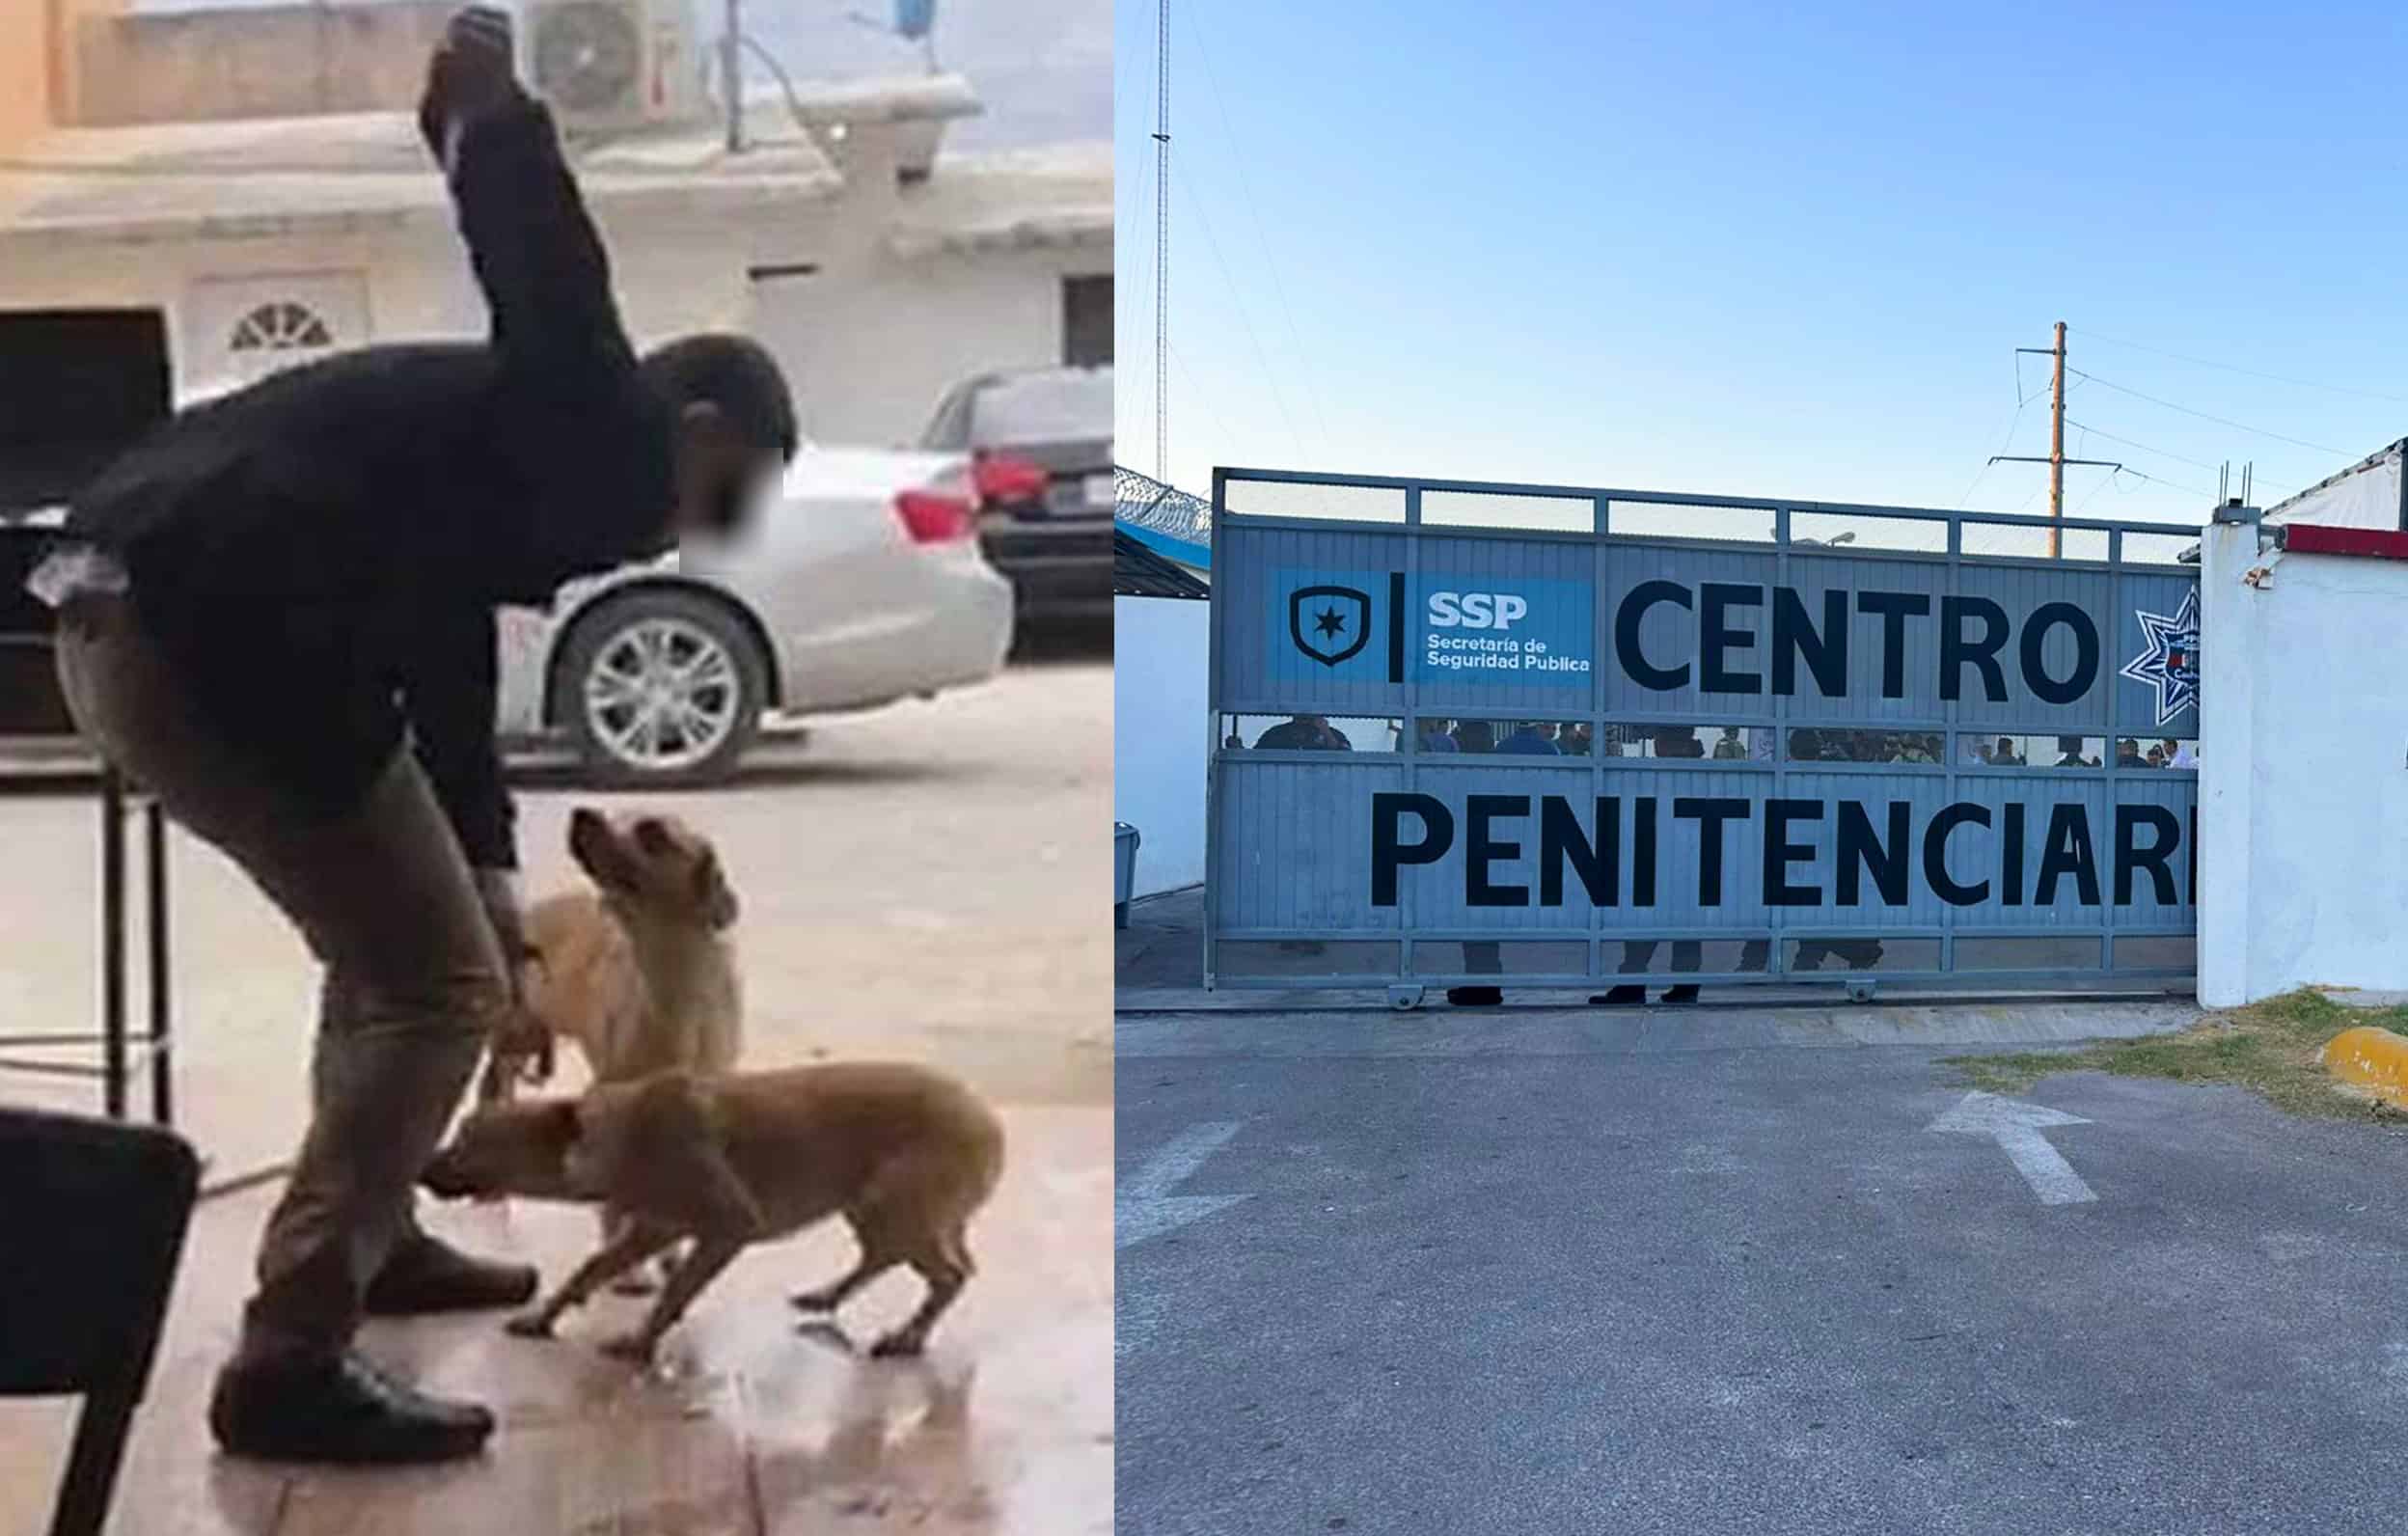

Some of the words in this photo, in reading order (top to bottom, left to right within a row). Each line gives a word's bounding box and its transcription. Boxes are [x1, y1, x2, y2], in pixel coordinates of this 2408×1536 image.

[1428, 591, 1527, 630] SSP
[1427, 634, 1519, 653] Secretaría
[1524, 638, 1547, 653] de
[1615, 580, 2099, 704] CENTRO
[1427, 650, 1519, 670] Seguridad
